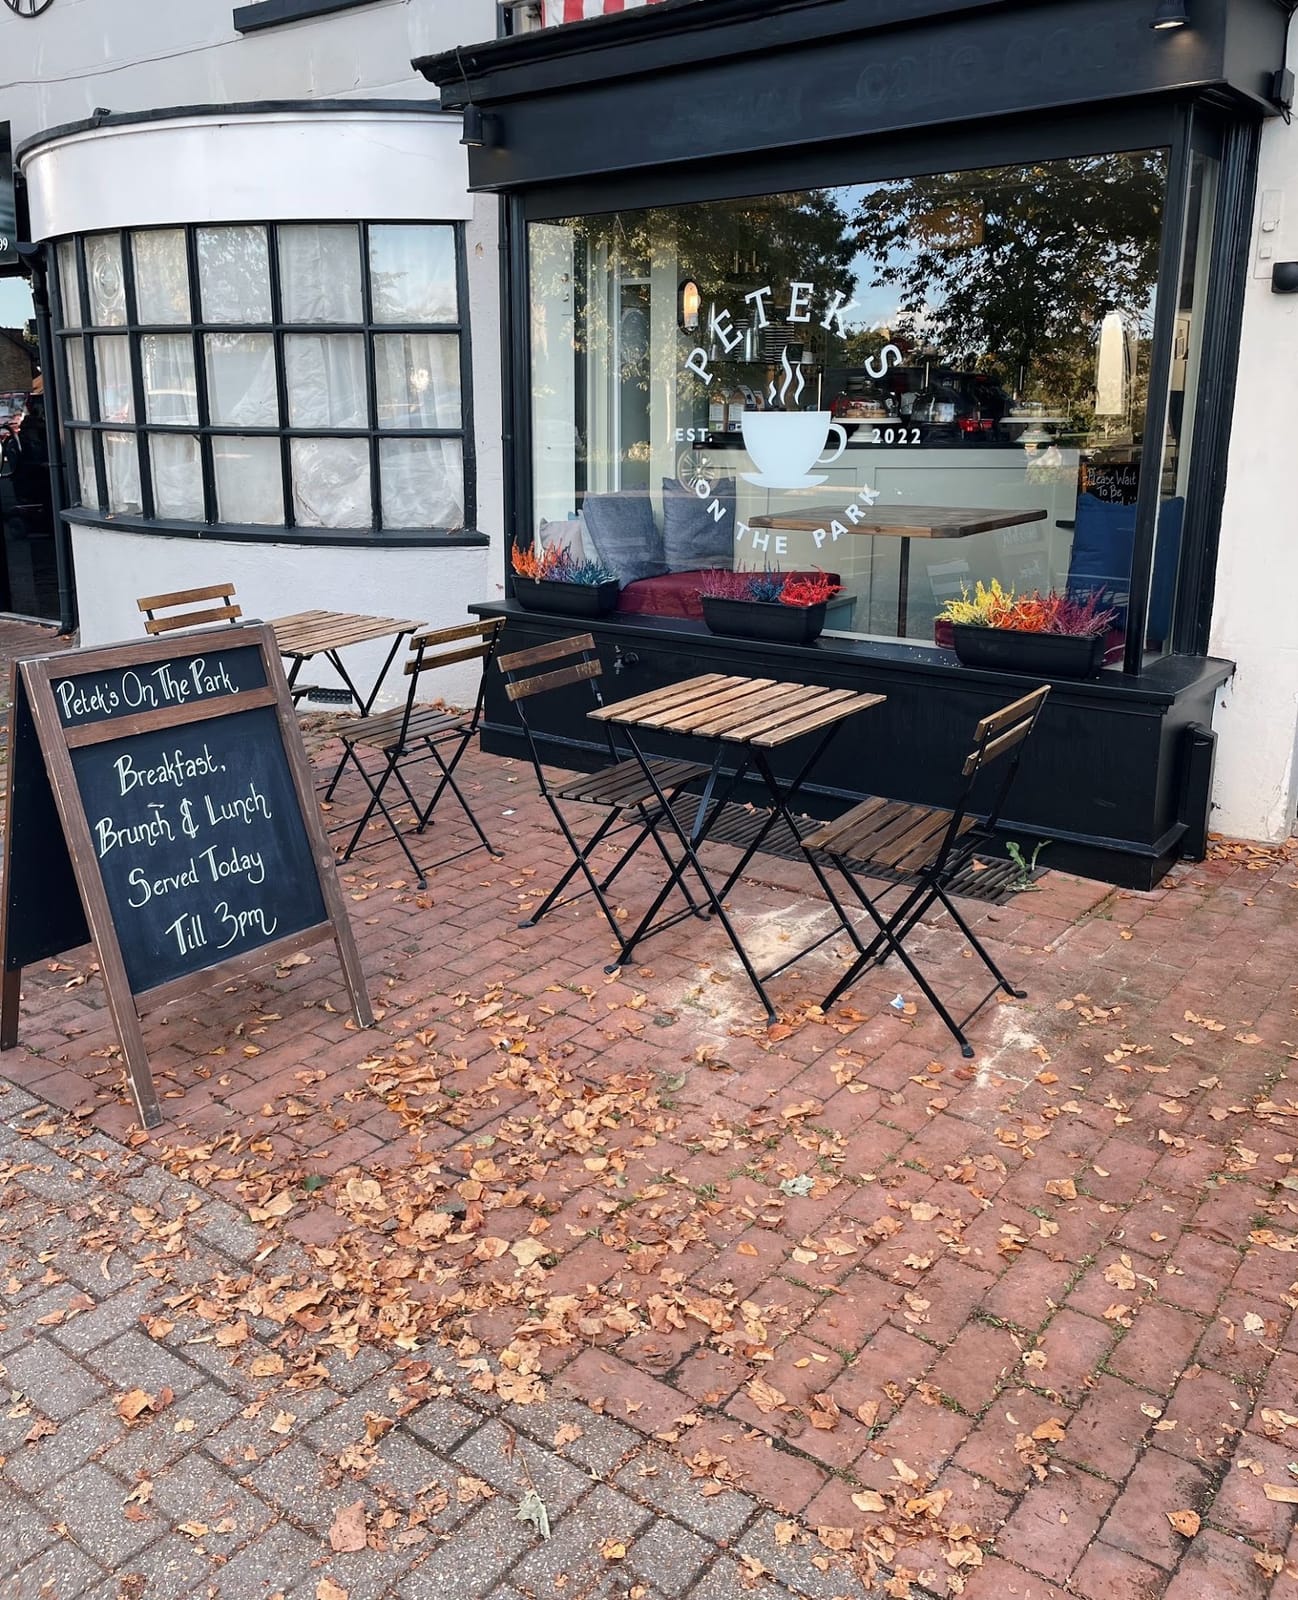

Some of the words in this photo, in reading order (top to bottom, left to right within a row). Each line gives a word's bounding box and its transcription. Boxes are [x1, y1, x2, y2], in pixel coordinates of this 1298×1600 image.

[675, 427, 713, 442] EST.
[872, 428, 921, 445] 2022
[1087, 466, 1114, 486] Please
[1116, 467, 1137, 485] Wait
[1097, 485, 1108, 496] To
[1110, 484, 1123, 498] Be
[695, 479, 726, 522] ON
[736, 521, 788, 554] THE
[812, 484, 880, 549] PARK
[57, 680, 120, 719] Petek's
[122, 671, 158, 707] On
[152, 663, 191, 703] The
[189, 658, 239, 695] Park
[114, 744, 227, 797] Breakfast,
[95, 806, 175, 859] Brunch
[180, 798, 199, 839] &
[205, 783, 272, 826] Lunch
[128, 859, 199, 908] Served
[199, 845, 265, 884] Today
[165, 912, 208, 956] Till
[214, 902, 277, 949] 3pm
